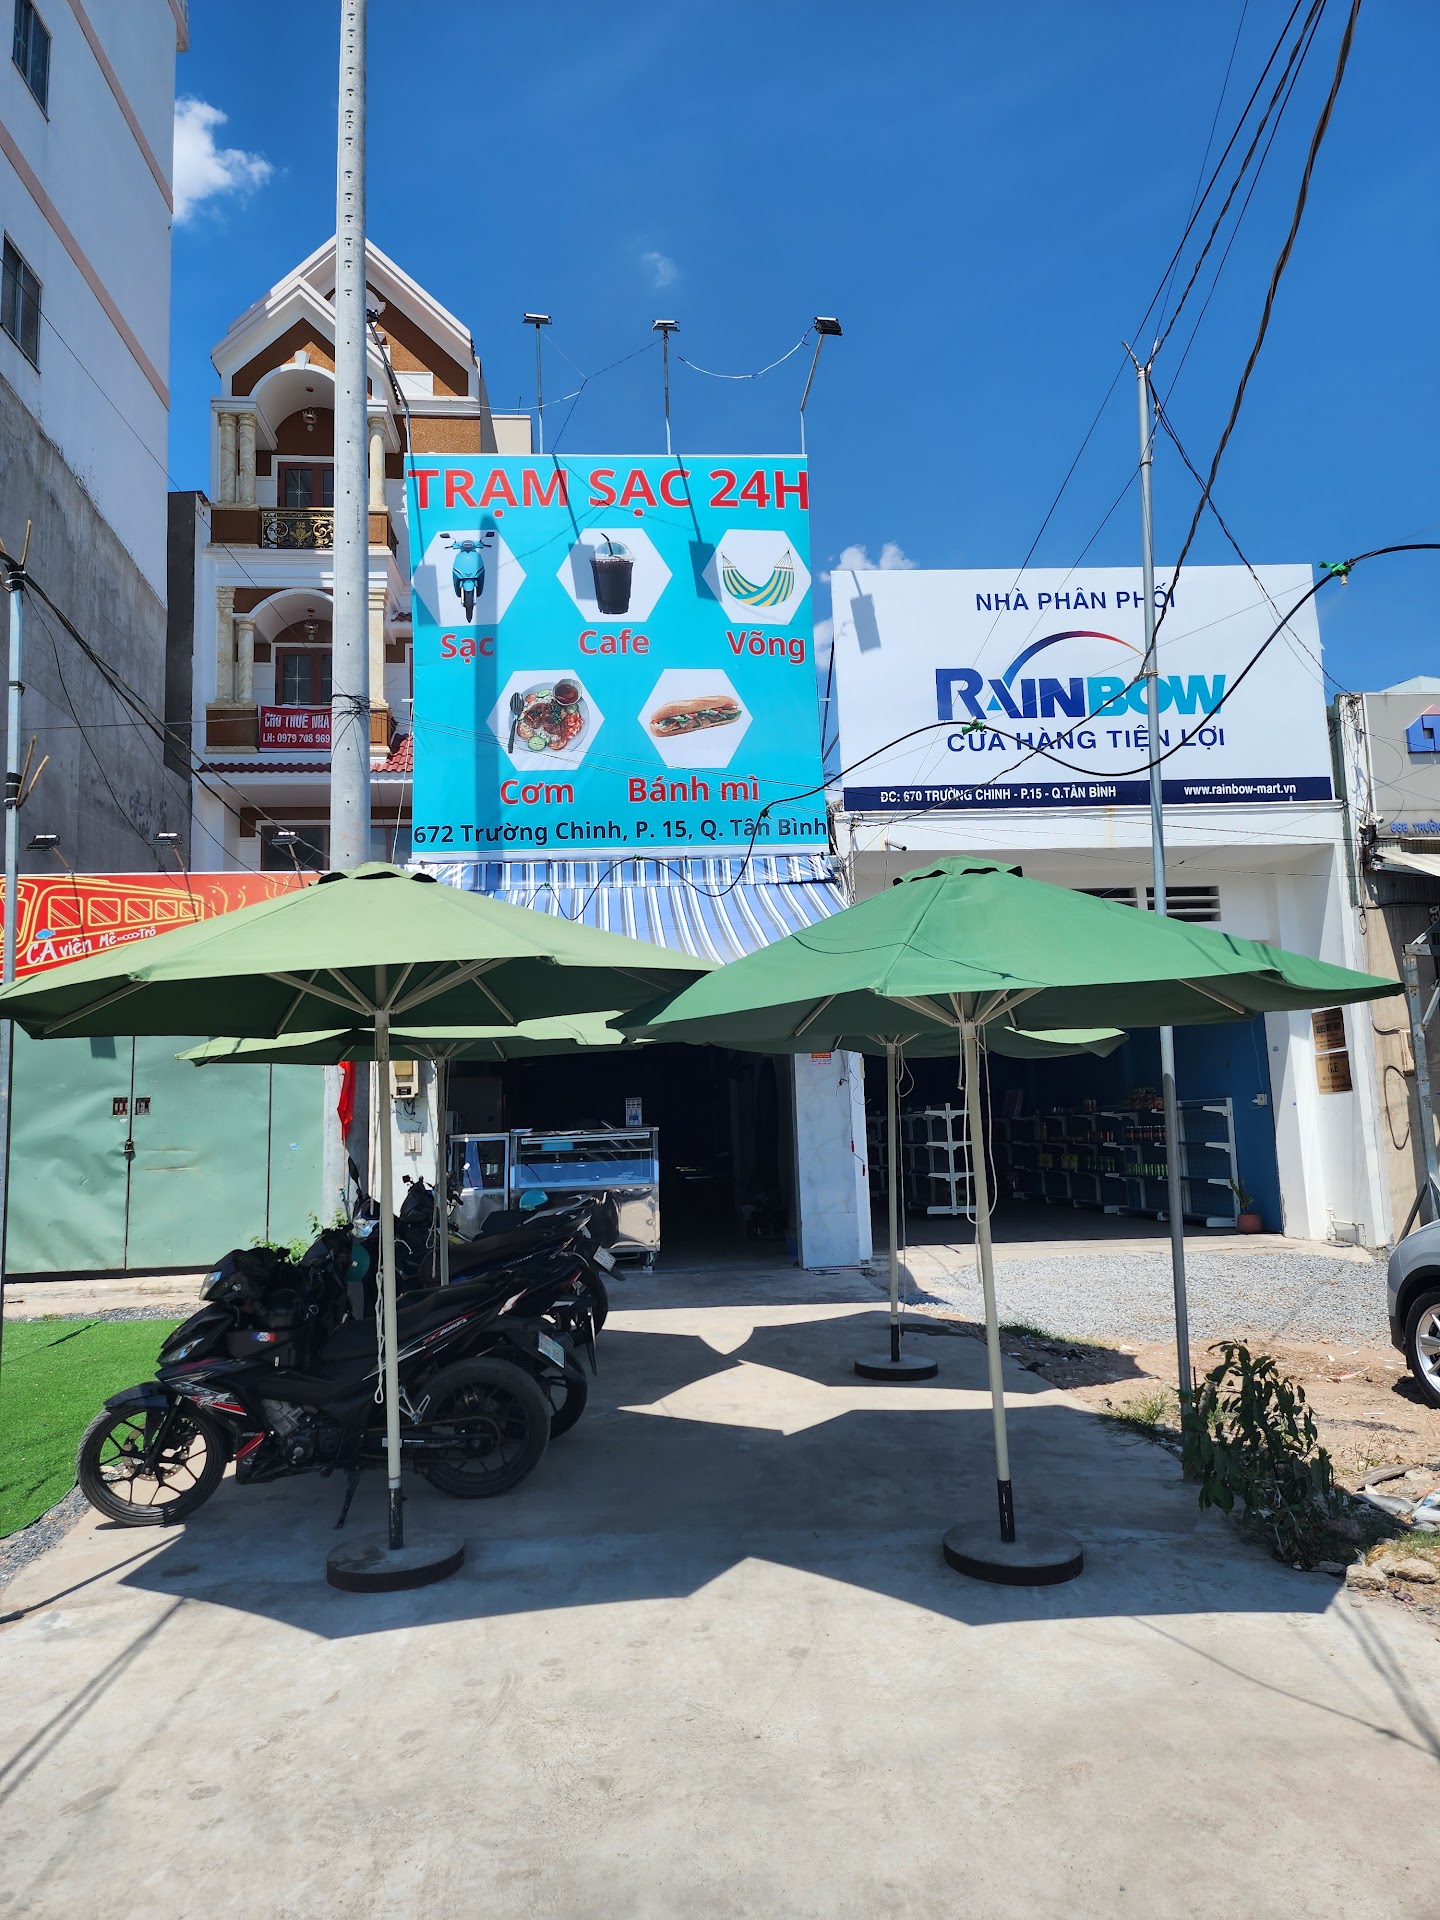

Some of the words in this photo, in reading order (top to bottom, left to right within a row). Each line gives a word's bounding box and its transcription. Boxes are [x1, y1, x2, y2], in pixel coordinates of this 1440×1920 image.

[407, 467, 569, 519] TRẠM
[588, 468, 691, 517] SẠC
[708, 470, 810, 511] 24H
[975, 587, 1030, 611] NHÀ
[1037, 587, 1107, 610] PHÂN
[440, 633, 495, 664] Sạc
[578, 628, 651, 655] Cafe
[726, 630, 806, 664] Võng
[935, 667, 1227, 721] RAINBOW
[262, 732, 275, 743] LH:
[277, 733, 297, 743] 0979
[299, 733, 314, 743] 708
[315, 733, 331, 744] 969
[1016, 726, 1097, 751] HÀNG
[1181, 726, 1226, 752] LỢI
[499, 778, 575, 805] Cơm
[628, 776, 718, 803] Bánh
[720, 775, 760, 802] mì
[903, 790, 923, 802] 670
[924, 786, 972, 802] TRƯỜNG
[975, 788, 1011, 801] CHINH
[1020, 787, 1042, 800] P.15
[1051, 784, 1086, 800] Q.TÂN
[1088, 783, 1117, 798] BÌNH
[1183, 783, 1297, 796] www.rainbow-mart.vn
[413, 825, 454, 844] 672
[460, 822, 548, 846] Trường
[556, 821, 628, 842] Chinh,
[636, 822, 655, 839] P.
[662, 821, 694, 841] 15,
[701, 820, 724, 839] Q.
[731, 817, 771, 836] Tân
[778, 815, 828, 837] Bình
